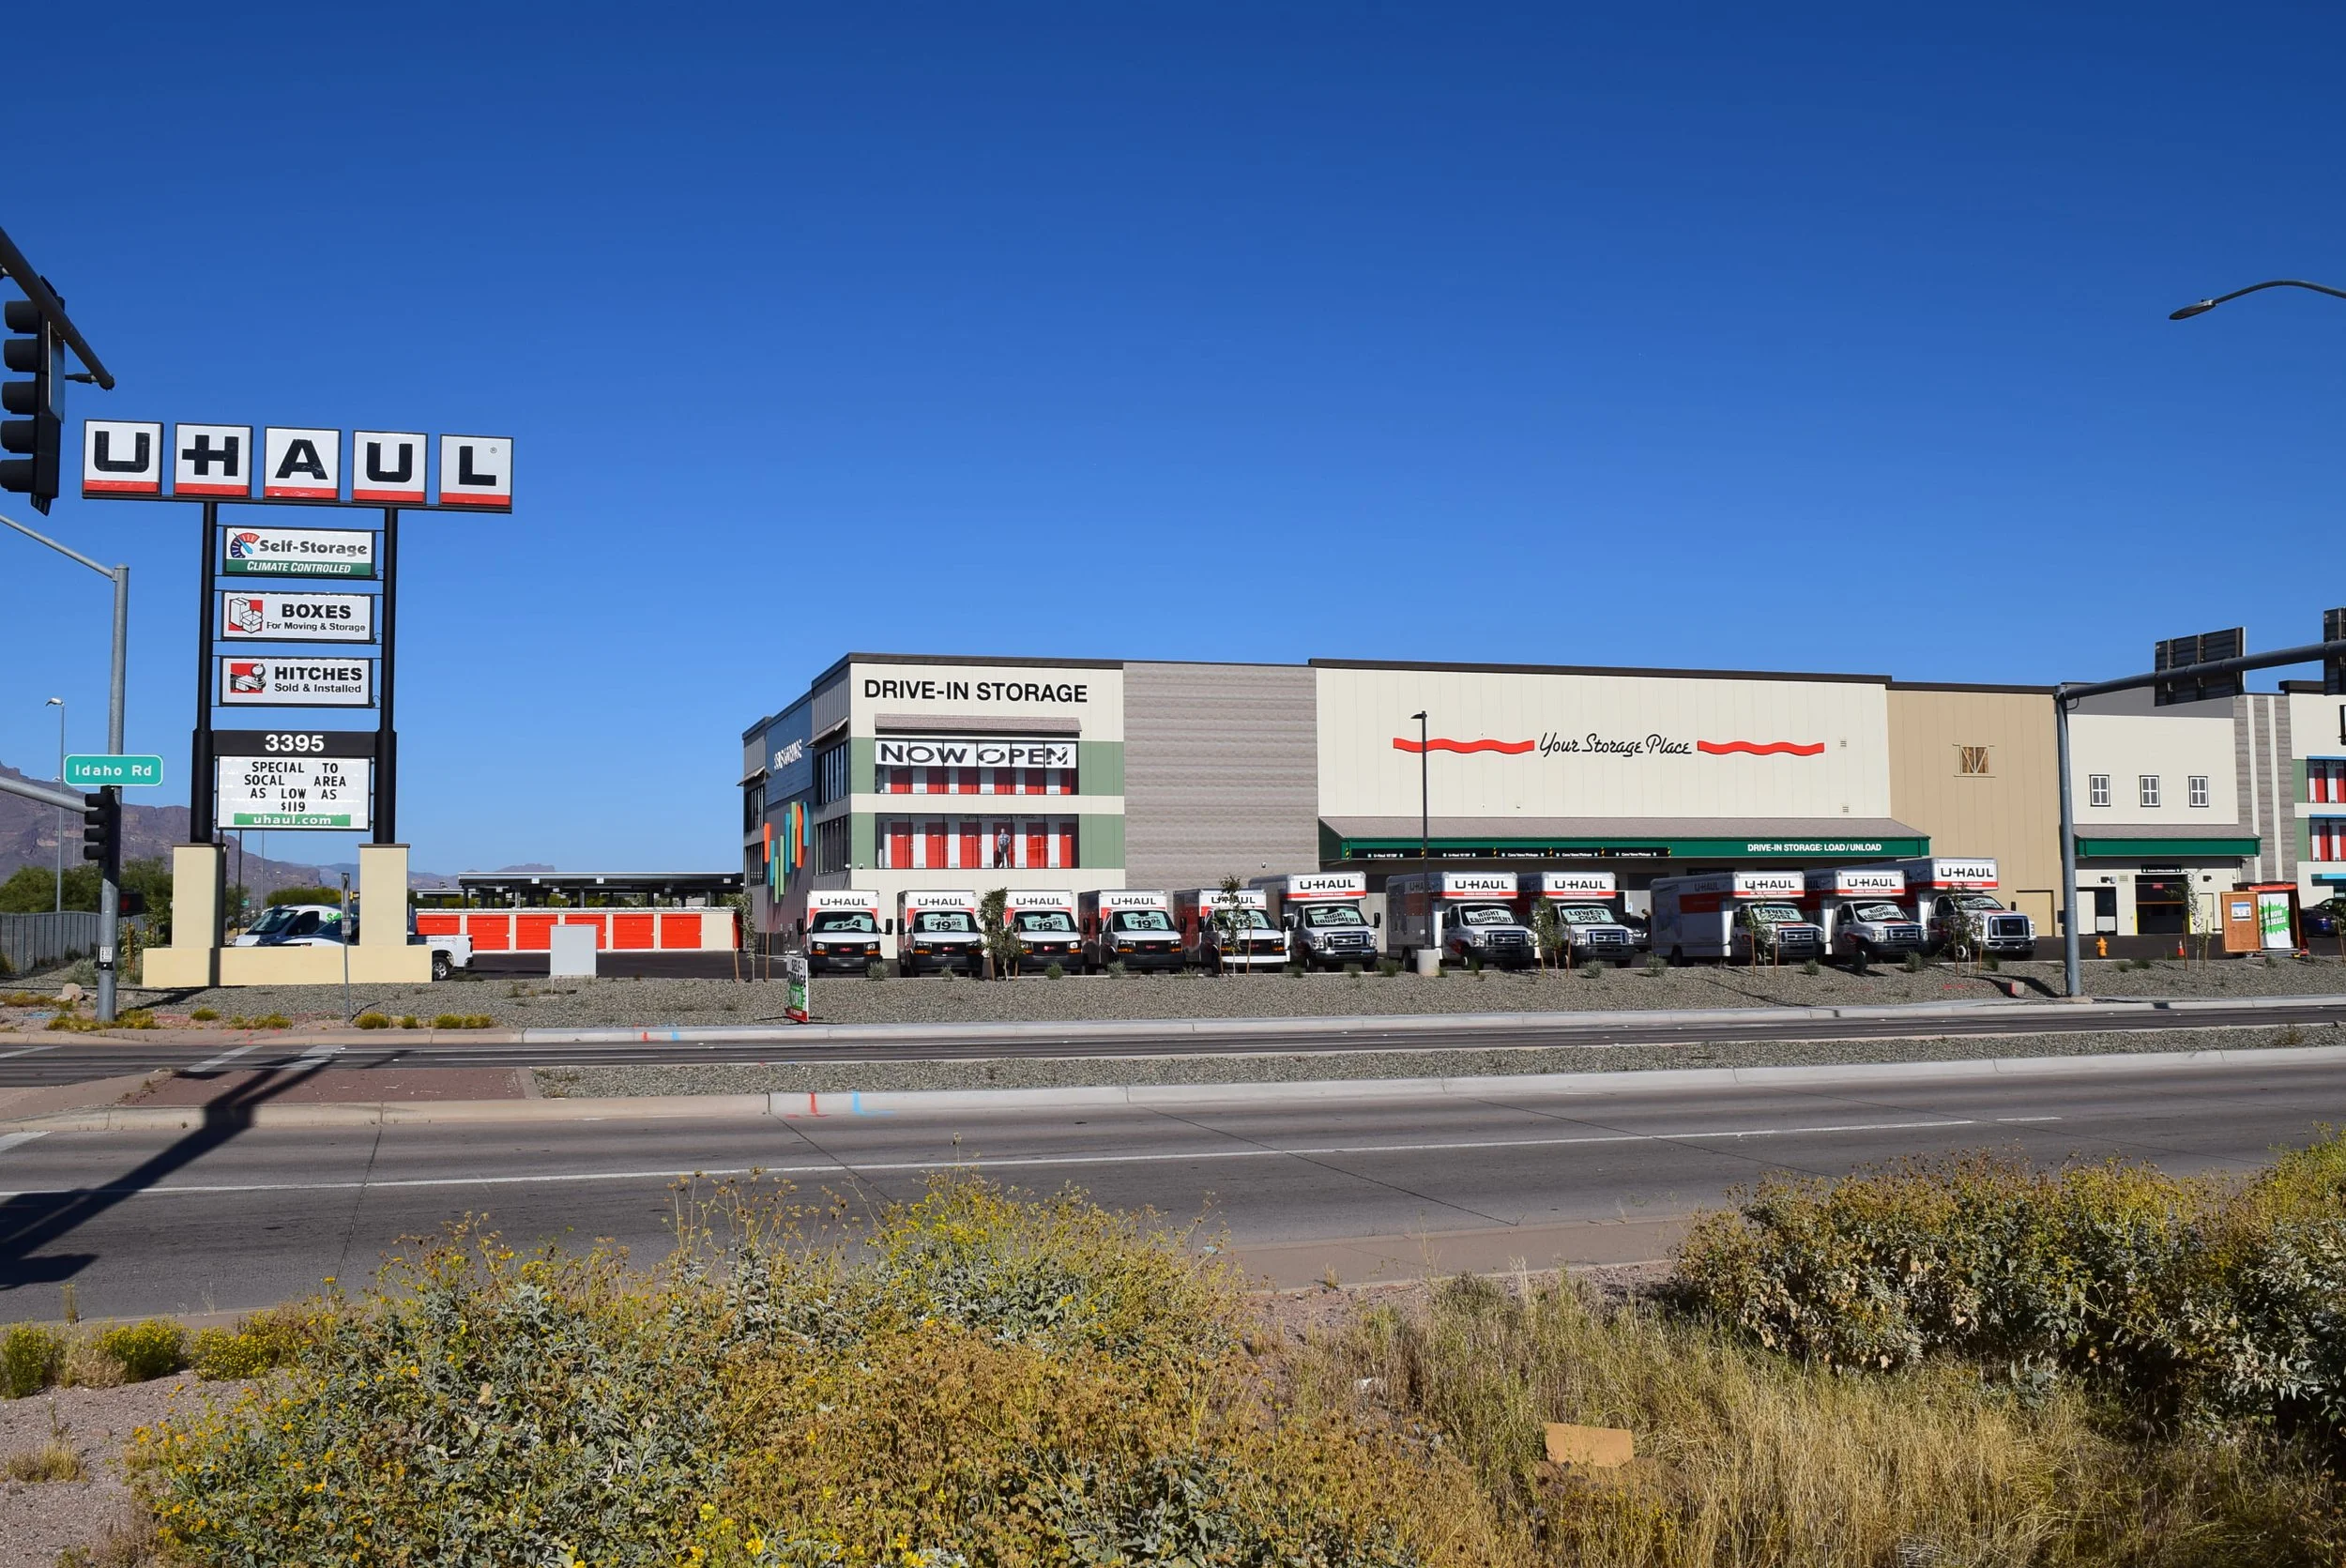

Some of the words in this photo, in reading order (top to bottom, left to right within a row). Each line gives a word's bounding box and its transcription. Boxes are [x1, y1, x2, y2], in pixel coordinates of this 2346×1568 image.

[259, 540, 367, 556] Self-Storage
[247, 561, 289, 572] CLIMATE
[290, 562, 351, 573] CONTROLLED
[282, 603, 351, 619] BOXES
[283, 622, 317, 632] Moving
[329, 623, 366, 632] Storage
[274, 666, 362, 681] HITCHES
[274, 683, 299, 693] Sold
[302, 683, 311, 692] &
[314, 684, 361, 693] Installed
[864, 679, 969, 700] DRIVE-IN
[976, 682, 1088, 703] STORAGE
[265, 734, 325, 752] 3395
[1540, 732, 1580, 757] Your
[1581, 733, 1643, 757] Storage
[1645, 734, 1692, 754] Place
[880, 742, 967, 764] NOW
[978, 747, 1068, 765] OPEN
[75, 764, 122, 776] Idaho
[131, 765, 152, 776] Rd
[251, 761, 304, 773] SPECIAL
[322, 762, 339, 773] TO
[244, 774, 285, 786] SOCAL
[313, 776, 346, 786] AREA
[250, 787, 267, 799] AS
[281, 788, 306, 799] LOW
[321, 789, 337, 799] AS
[281, 801, 306, 813] $119
[253, 814, 331, 825] uhaul.com
[1868, 905, 1888, 913] RIGHT
